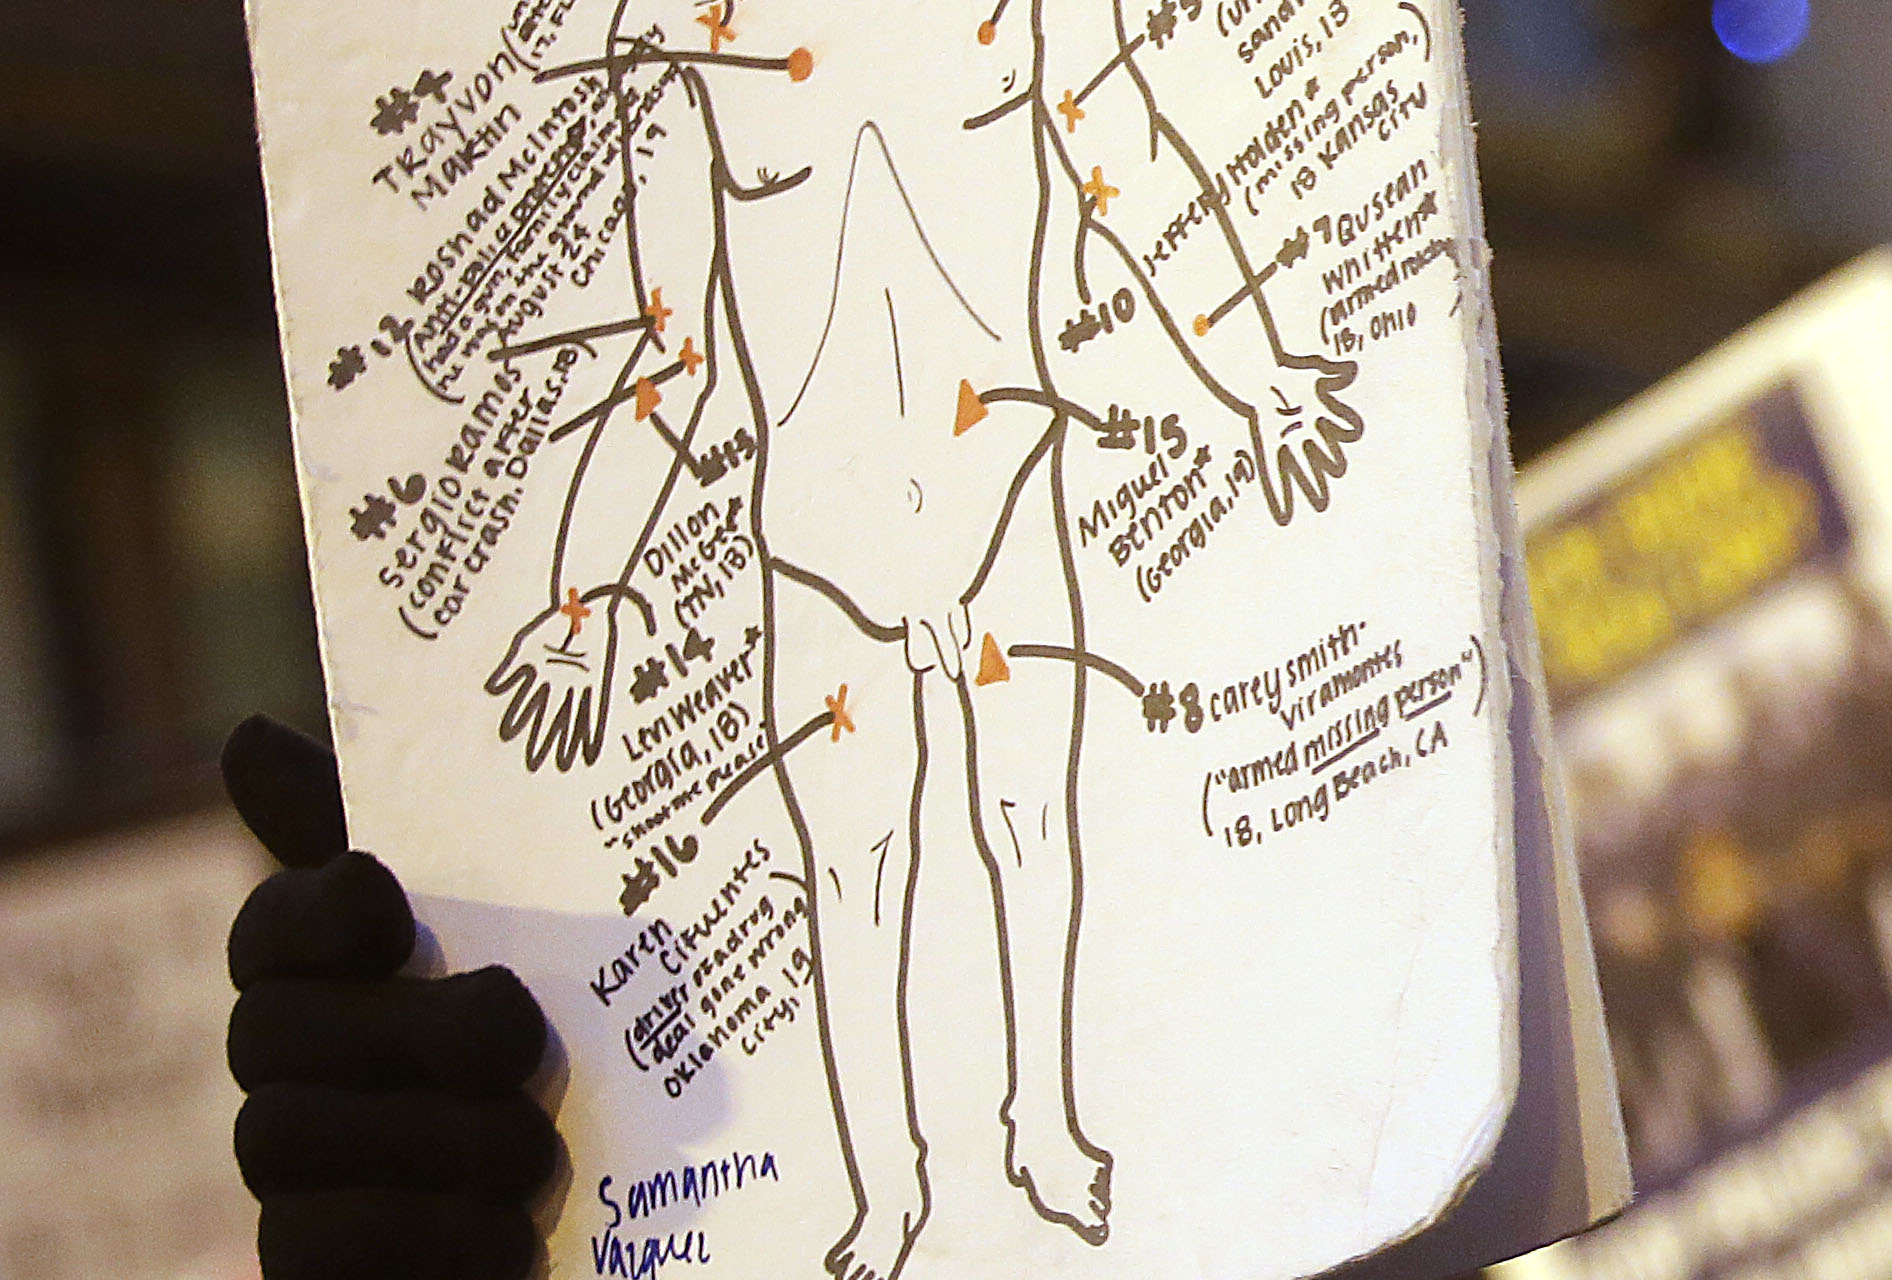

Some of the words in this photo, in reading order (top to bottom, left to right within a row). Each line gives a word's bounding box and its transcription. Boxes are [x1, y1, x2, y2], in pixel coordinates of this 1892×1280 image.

[1255, 34, 1321, 99] Louis,
[497, 63, 602, 196] McIntosh
[1058, 288, 1135, 353] #10
[1084, 404, 1187, 459] #15
[349, 473, 426, 541] #6
[1079, 453, 1176, 547] Miguel
[643, 502, 720, 578] Dillon
[1142, 681, 1204, 733] #8
[1416, 721, 1447, 757] CA
[619, 835, 698, 918] #16
[590, 918, 673, 1007] Karen
[598, 1152, 778, 1229] Samantha
